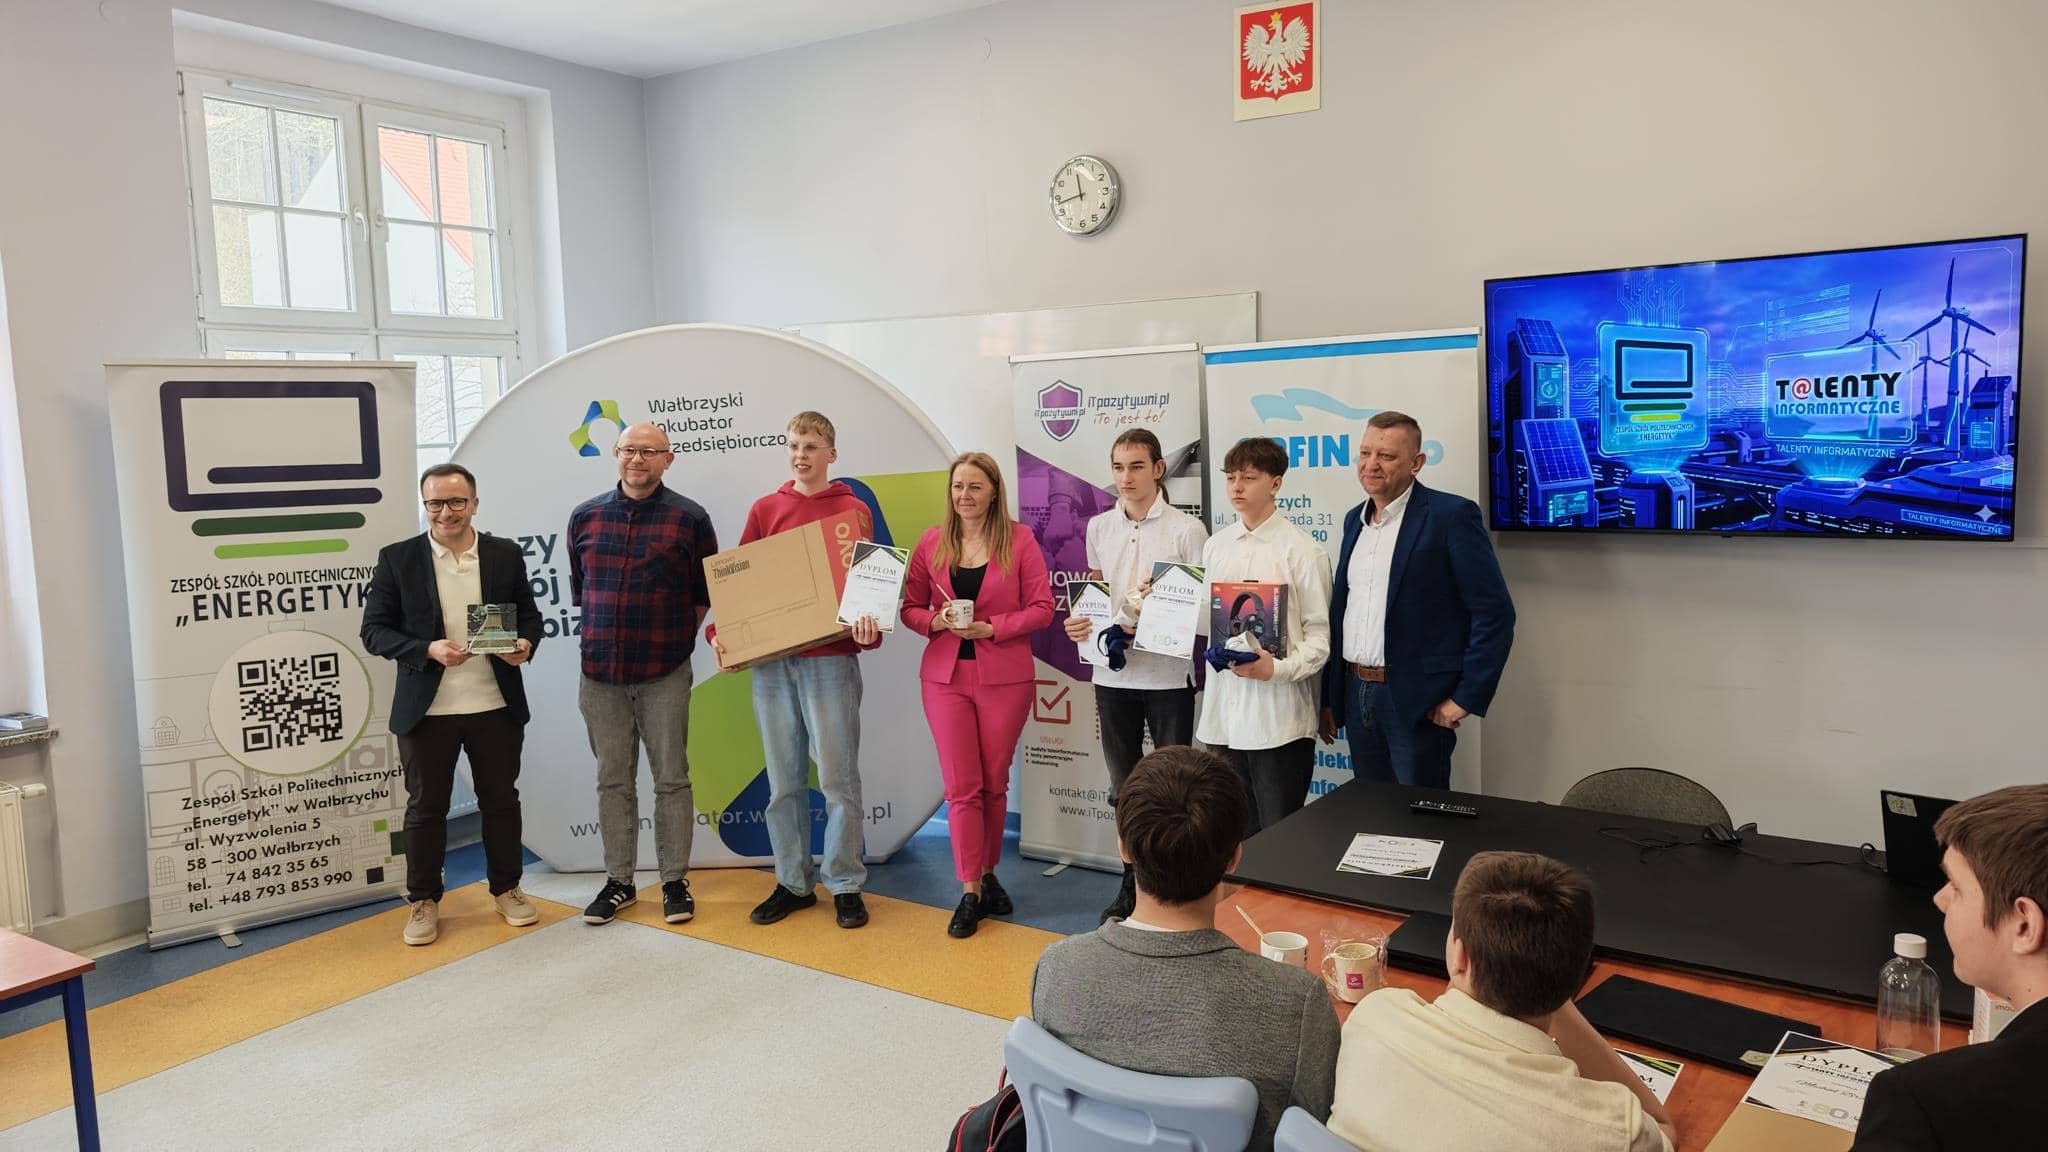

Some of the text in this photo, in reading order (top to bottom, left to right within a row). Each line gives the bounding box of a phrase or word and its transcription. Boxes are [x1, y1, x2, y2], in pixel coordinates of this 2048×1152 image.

[1098, 173, 1105, 181] 2
[1102, 187, 1109, 195] 3
[1080, 220, 1086, 228] 6
[1091, 214, 1098, 222] 5
[1776, 372, 1902, 400] T@LENTY
[648, 392, 743, 413] Wałbrzyski
[1088, 393, 1170, 410] iTpozytywni.pl
[1776, 400, 1900, 415] INFORMATYCZNE
[651, 417, 733, 433] nkubator
[1115, 411, 1140, 428] jest
[1145, 409, 1166, 424] to!
[672, 434, 787, 454] zedsiębiorczo
[1776, 444, 1896, 458] TALENTY INFORMATYCZNE
[1215, 513, 1228, 525] ul.
[1317, 513, 1334, 526] 31
[1908, 512, 2002, 534] TALENTY INFORMATYCZNE
[1312, 530, 1328, 542] 80
[518, 533, 557, 564] zy
[860, 563, 897, 576] DYPLOM
[171, 574, 221, 593] ZESPÓŁ
[224, 571, 265, 589] SZKÓŁ
[529, 567, 560, 605] ój
[1155, 583, 1194, 596] DYPLOM
[182, 790, 236, 811] Zespół
[241, 783, 283, 800] Szkół
[285, 805, 299, 814] w
[305, 789, 389, 811] Wałbrzychu
[1049, 784, 1109, 801] kontakt@iT
[1059, 806, 1115, 820] www.iTpoz
[185, 818, 321, 852] al. Wyzwolenia 5
[187, 858, 207, 871] 58
[227, 849, 257, 865] 300
[262, 835, 340, 857] Wałbrzych
[188, 856, 328, 893] tel. 74 842 35 65
[189, 871, 352, 913] tel. +48 793 853 990
